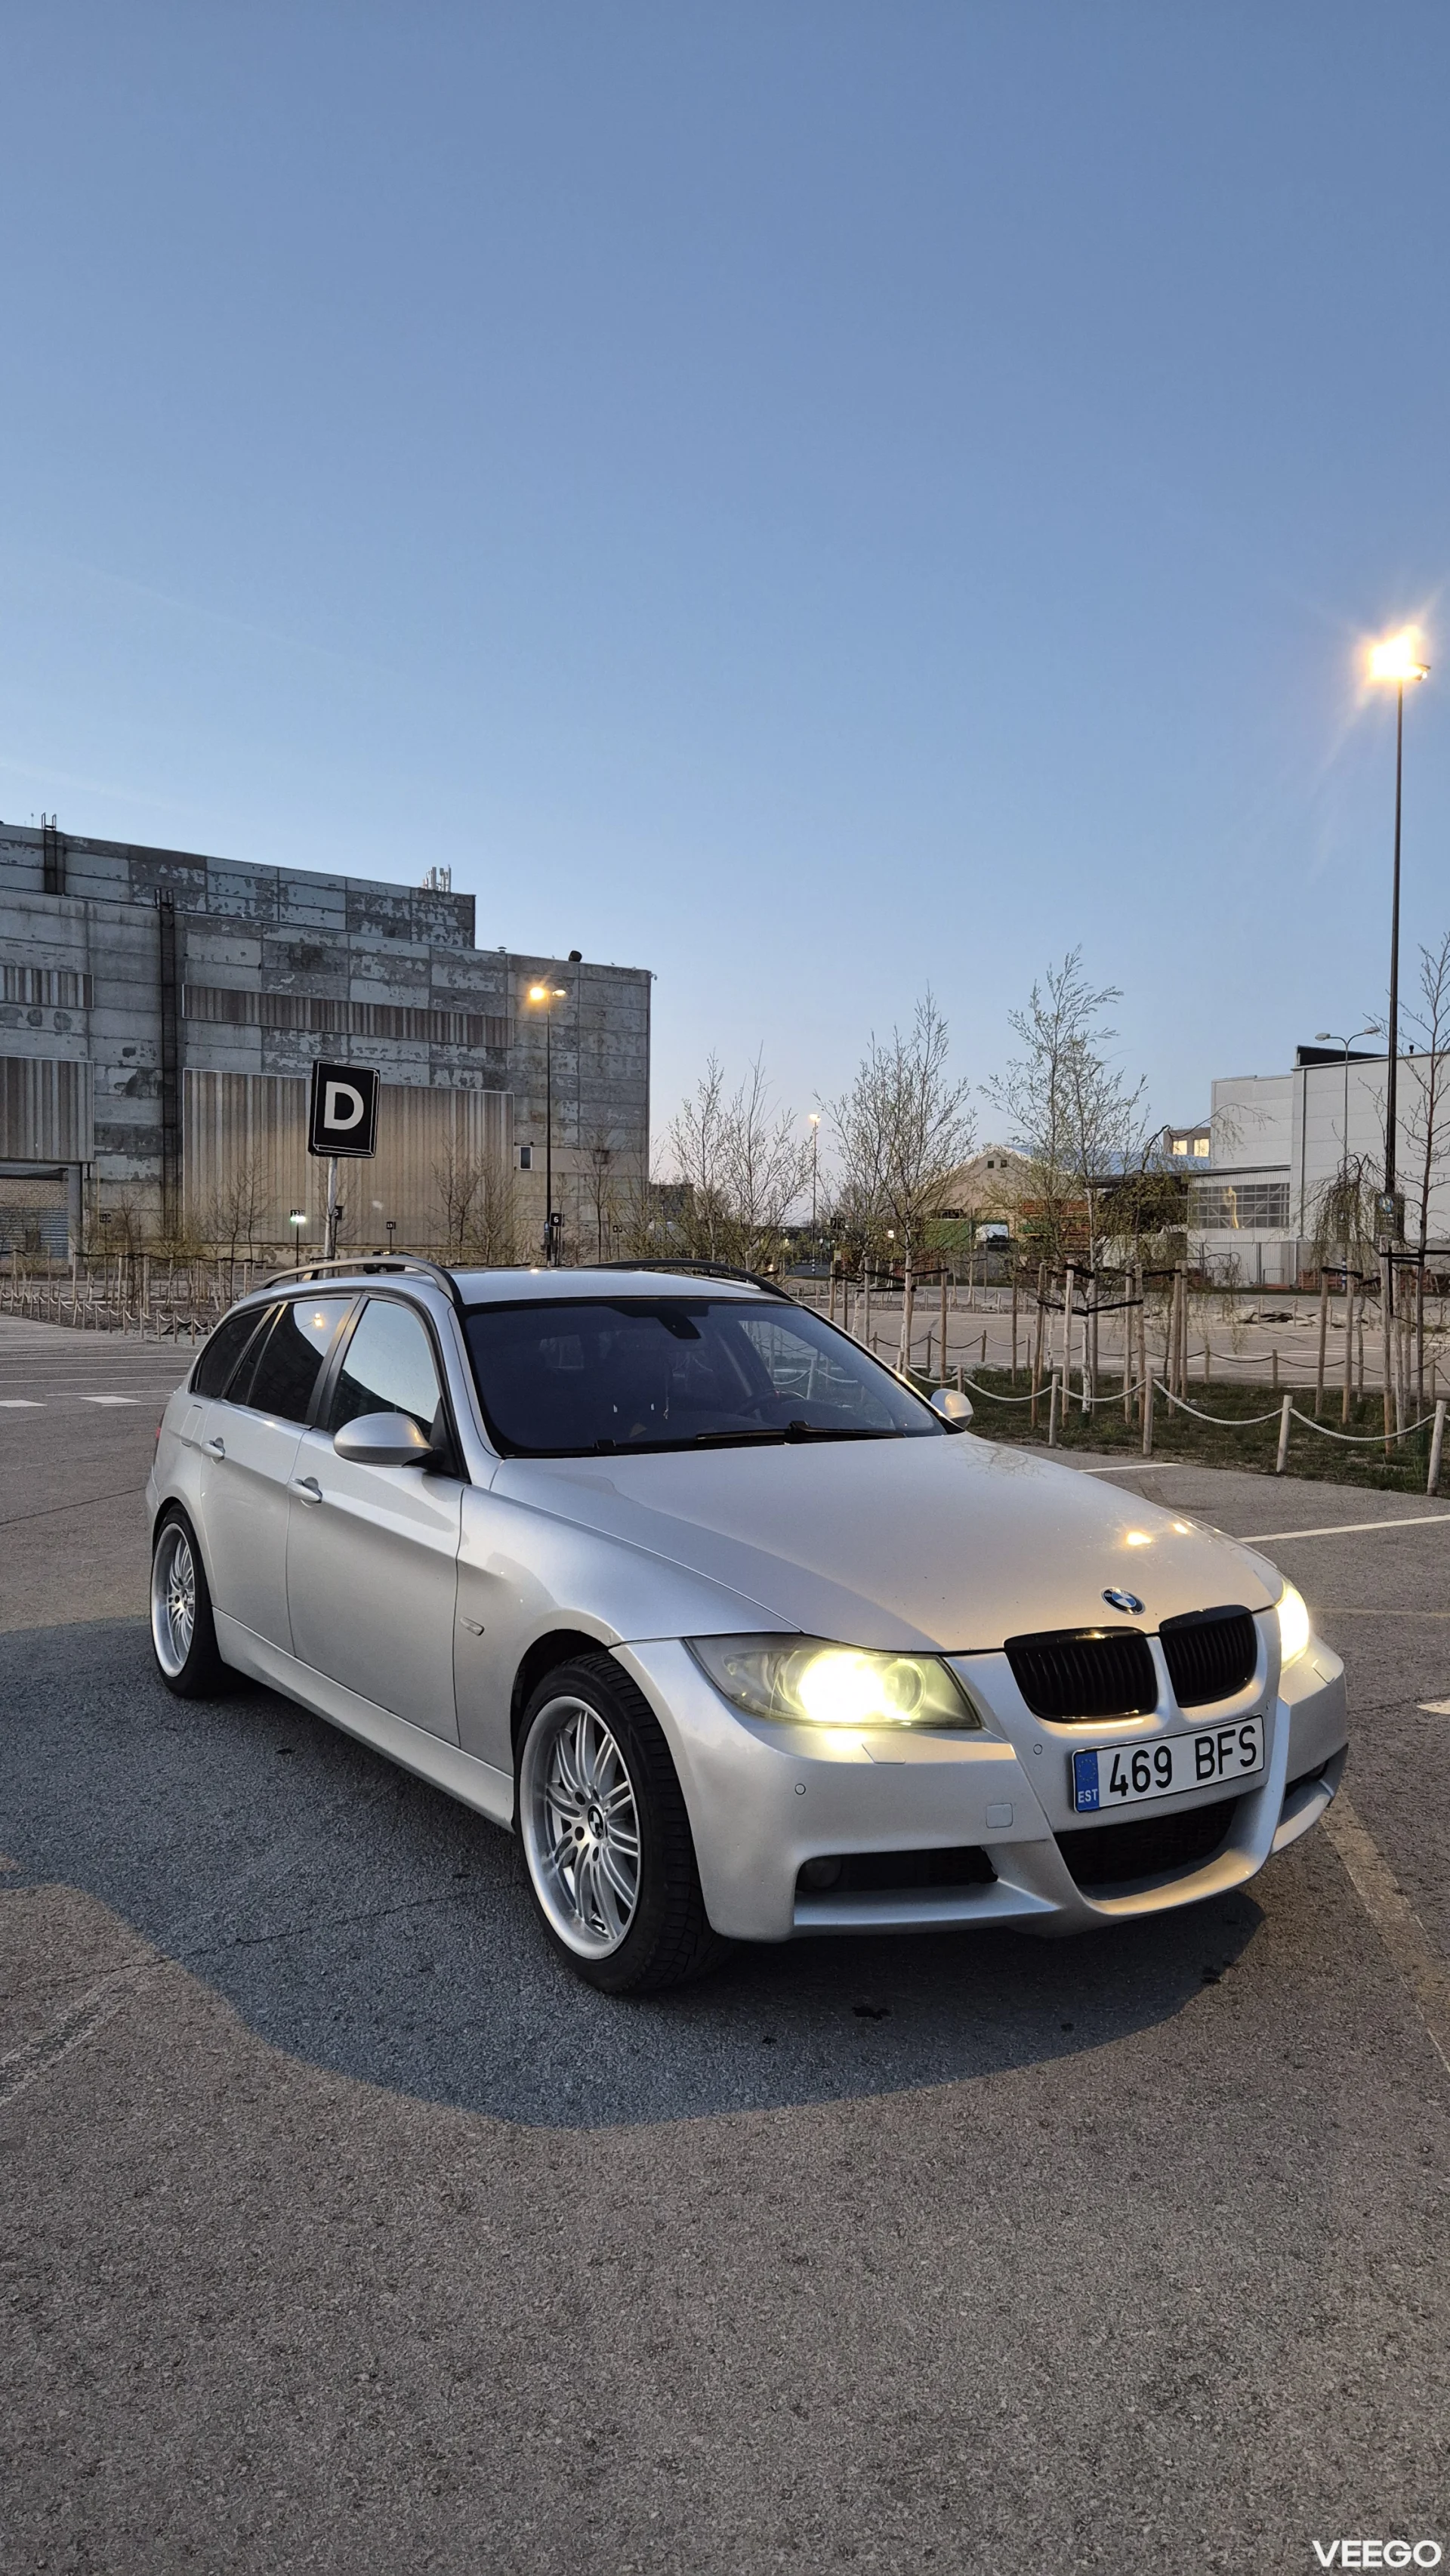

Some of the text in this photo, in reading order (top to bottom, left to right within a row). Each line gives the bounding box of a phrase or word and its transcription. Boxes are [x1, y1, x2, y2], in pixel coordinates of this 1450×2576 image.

[324, 1081, 364, 1130] D
[1109, 1725, 1257, 1796] 469 BFS
[1078, 1788, 1098, 1803] EST
